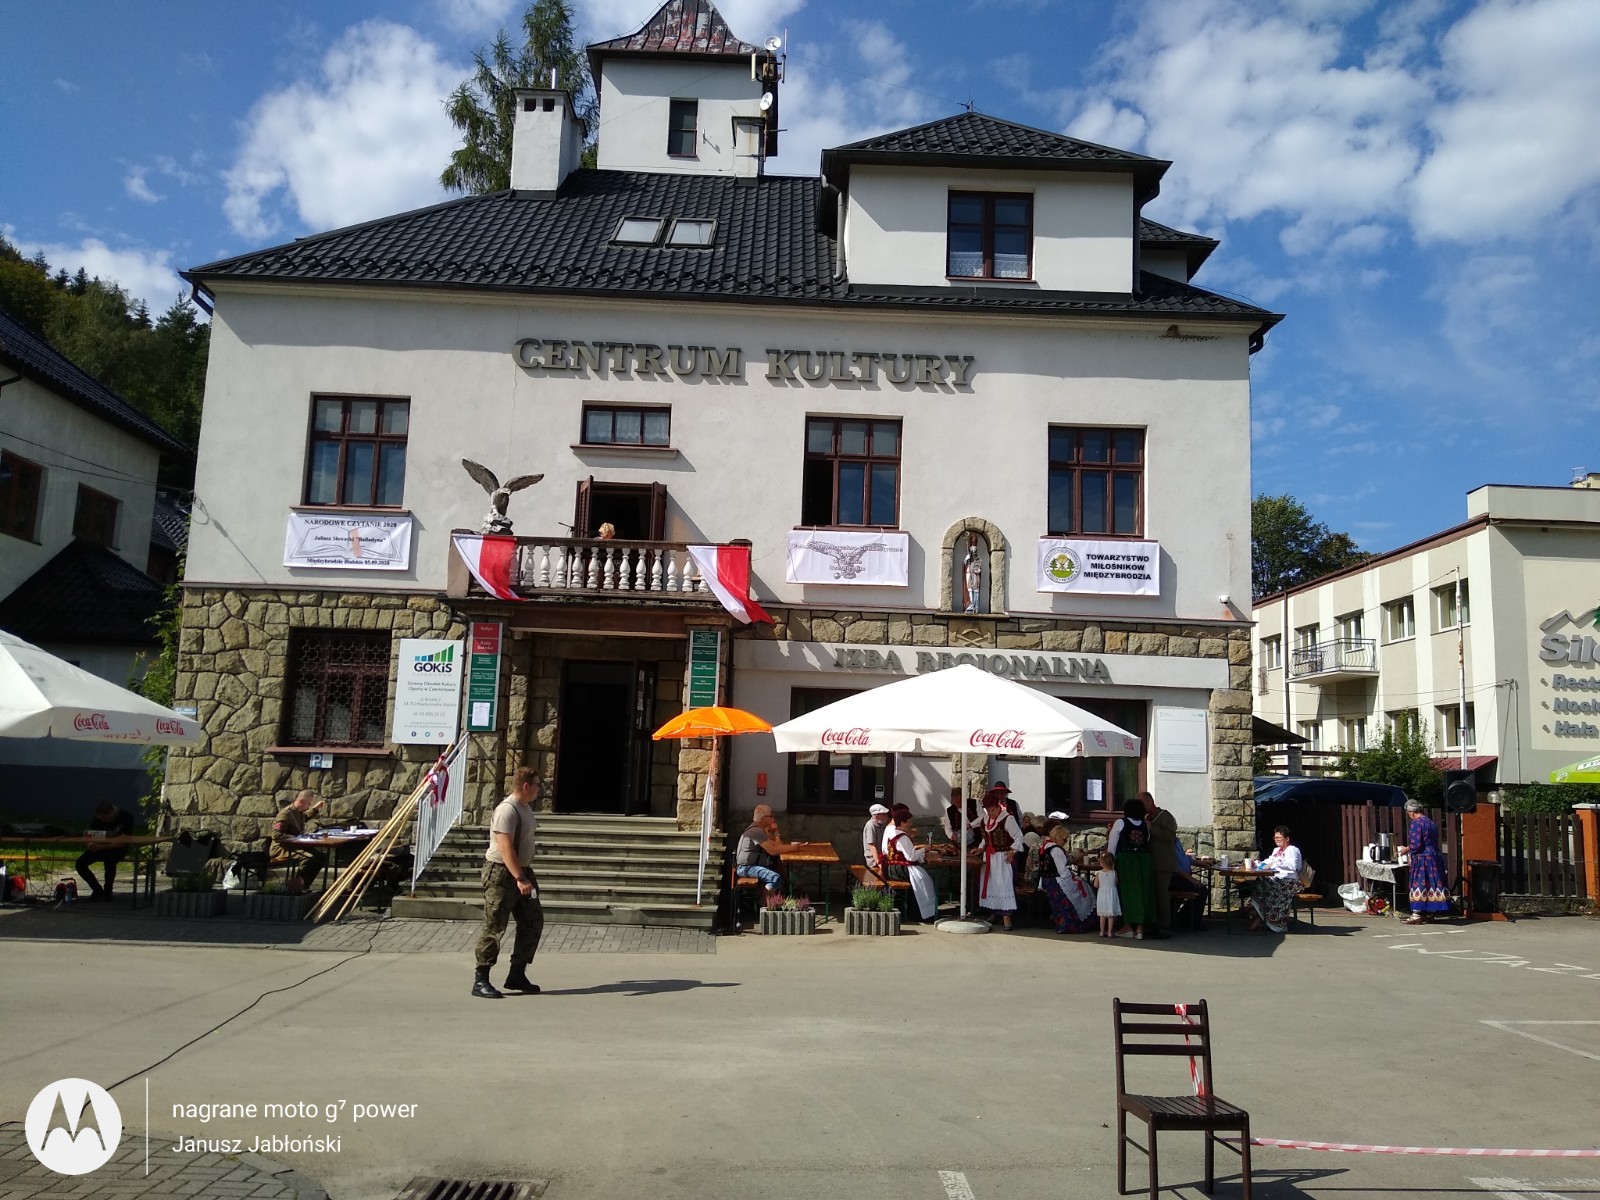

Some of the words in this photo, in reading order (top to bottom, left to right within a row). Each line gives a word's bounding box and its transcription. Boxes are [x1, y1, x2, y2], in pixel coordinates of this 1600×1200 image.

[511, 337, 741, 378] CENTRUM
[765, 348, 975, 386] KULTURY
[347, 520, 381, 528] CZYTANIE
[1086, 554, 1150, 563] TOWARZYSTWO
[1091, 562, 1145, 571] MIŁOŚNIKÓW
[1084, 571, 1152, 581] MIĘDZYBRODZIA
[414, 663, 452, 673] GOKiS
[834, 648, 900, 669] IZBA
[916, 651, 1109, 678] REGIONALNA
[1555, 721, 1598, 737] Hala
[821, 728, 871, 746] Coca-Cola
[969, 728, 1026, 750] Coca-Cola
